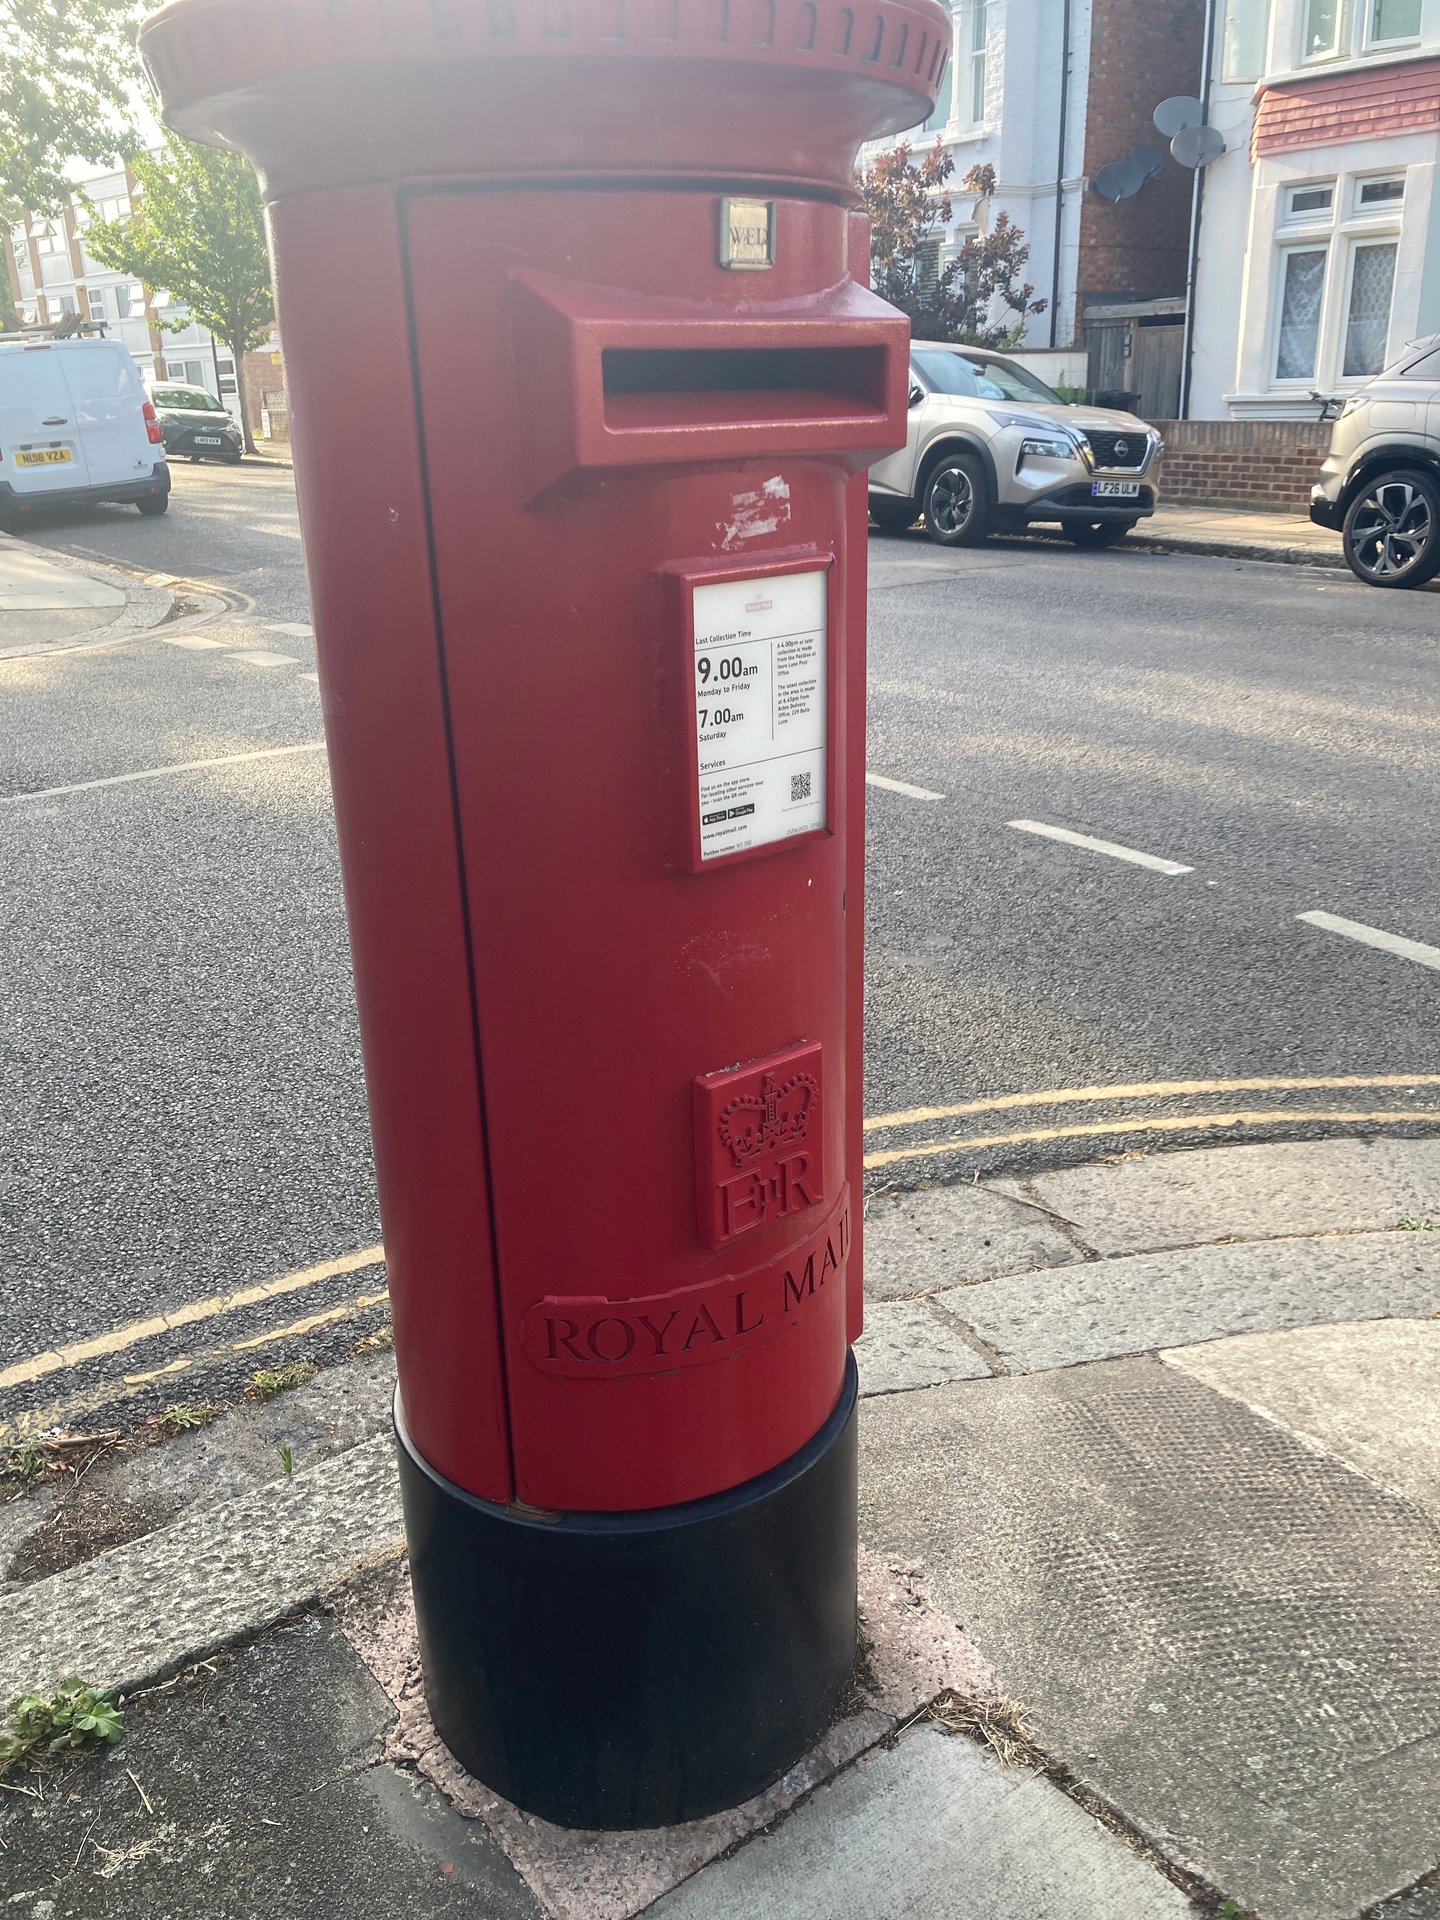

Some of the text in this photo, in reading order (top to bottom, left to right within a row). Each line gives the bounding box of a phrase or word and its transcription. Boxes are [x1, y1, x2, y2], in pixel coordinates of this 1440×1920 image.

[1098, 482, 1120, 494] LF26
[695, 630, 752, 645] Last Collection Time
[697, 656, 759, 684] 9.00am
[697, 688, 722, 698] Monday
[731, 682, 751, 691] Friday
[698, 708, 744, 729] 7.00am
[698, 730, 727, 742] Saturday
[699, 759, 726, 771] Services
[702, 824, 749, 840] www.royalmail.com
[719, 844, 736, 852] number
[540, 1290, 764, 1363] ROYAL
